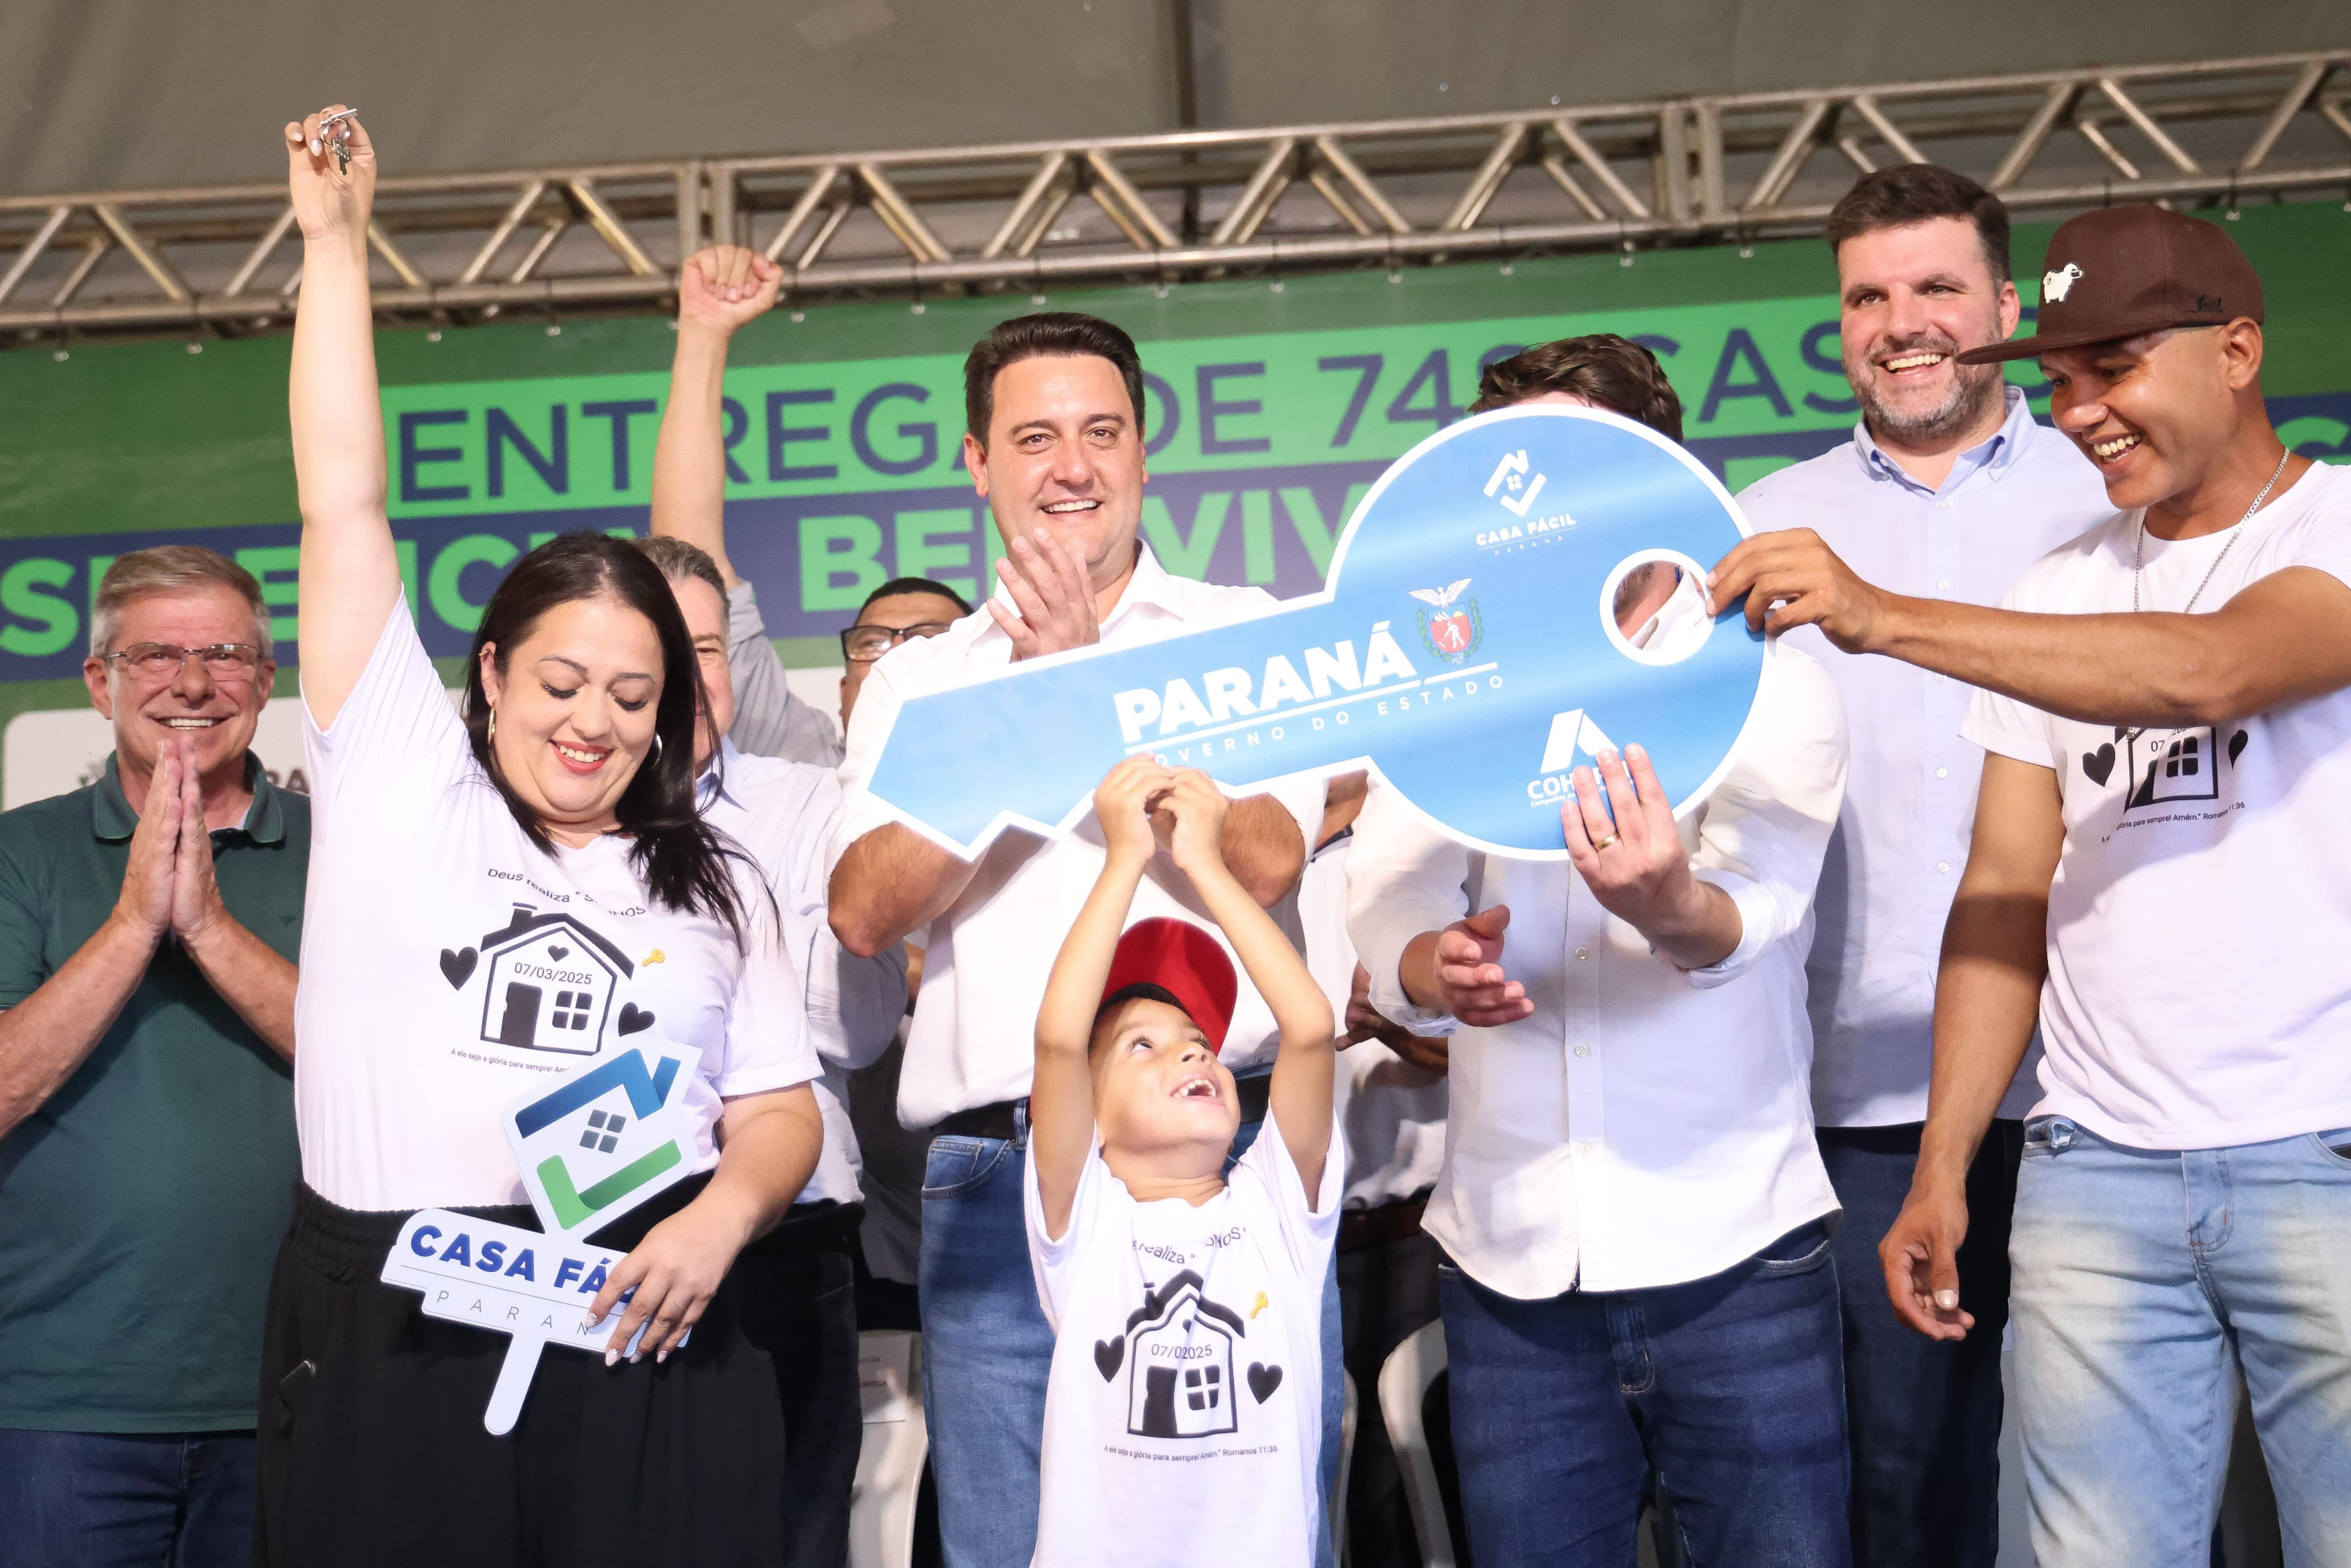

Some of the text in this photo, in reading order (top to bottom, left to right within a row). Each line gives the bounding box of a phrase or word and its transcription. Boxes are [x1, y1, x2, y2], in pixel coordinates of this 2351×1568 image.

[399, 381, 967, 503] ENTREG
[1476, 514, 1576, 546] CASA FÁCIL
[1495, 534, 1563, 555] PARANÁ
[1113, 620, 1418, 744] PARANÁ
[1154, 674, 1504, 766] OVERNO DO ESTADO
[526, 879, 570, 903] realiza
[514, 962, 593, 985] 07/03/2025
[468, 1053, 481, 1061] seja
[488, 1057, 508, 1065] glória
[526, 1064, 553, 1073] sempre!
[410, 1224, 535, 1282] CASA
[437, 1290, 589, 1336] PARAN
[1223, 1448, 1257, 1457] Romanos
[1259, 1445, 1278, 1453] 11:36
